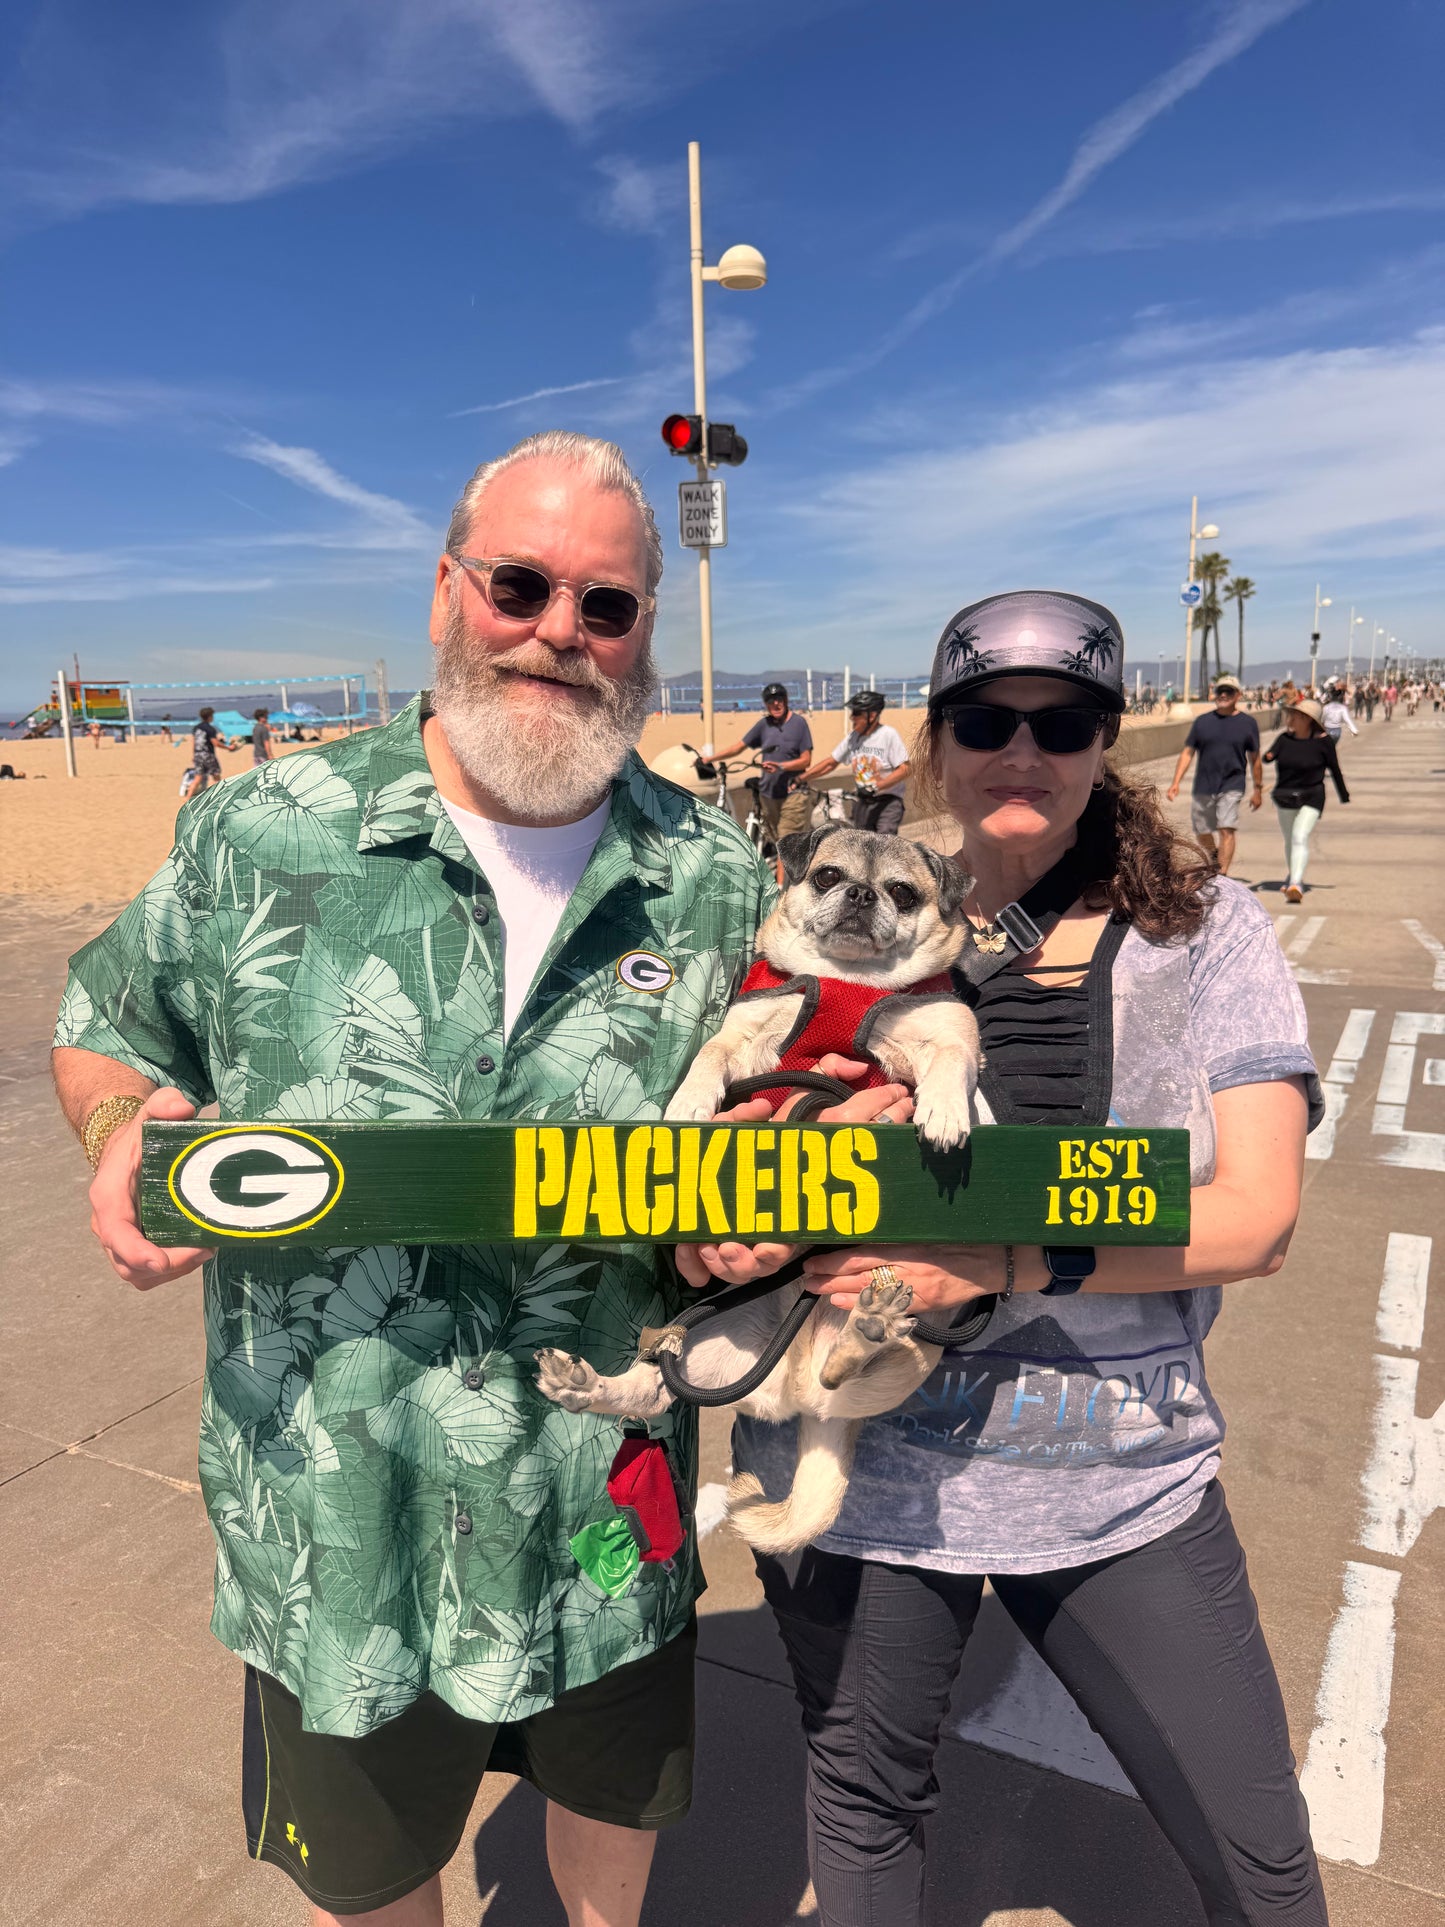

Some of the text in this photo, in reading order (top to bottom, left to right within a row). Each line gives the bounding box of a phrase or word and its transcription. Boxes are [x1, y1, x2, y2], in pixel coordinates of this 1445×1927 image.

[684, 490, 719, 503] WALK
[686, 508, 719, 520] ZONE
[686, 525, 719, 539] ONLY
[620, 953, 671, 990] G
[1059, 1138, 1149, 1179] EST
[181, 1126, 880, 1237] G PACKERS
[1045, 1184, 1157, 1226] 1919
